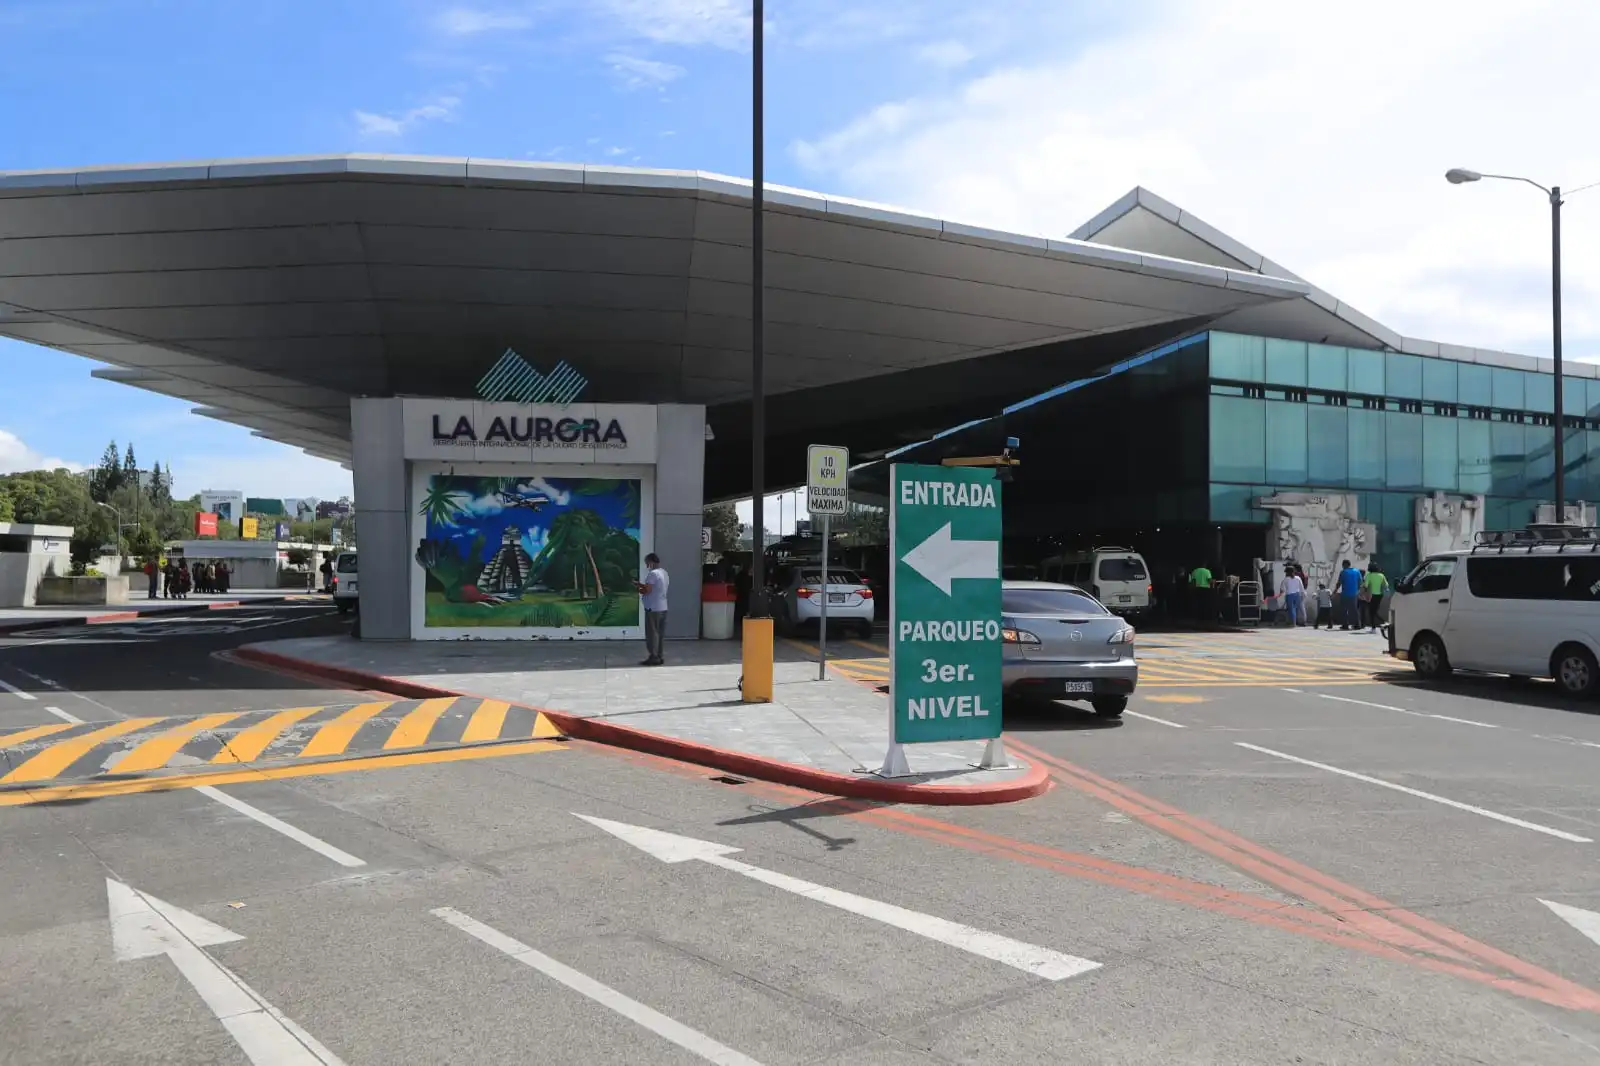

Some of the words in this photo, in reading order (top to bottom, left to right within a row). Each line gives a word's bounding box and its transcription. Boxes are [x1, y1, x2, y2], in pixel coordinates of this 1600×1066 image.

[432, 414, 477, 440] LA
[485, 416, 627, 443] AURORA
[820, 467, 836, 479] KPH
[824, 456, 834, 467] 10
[809, 486, 846, 497] VELOCIDAD
[900, 480, 997, 508] ENTRADA
[811, 499, 844, 511] MAXIMA
[900, 619, 1000, 642] PARQUEO
[920, 658, 975, 683] 3er.
[907, 694, 990, 721] NIVEL
